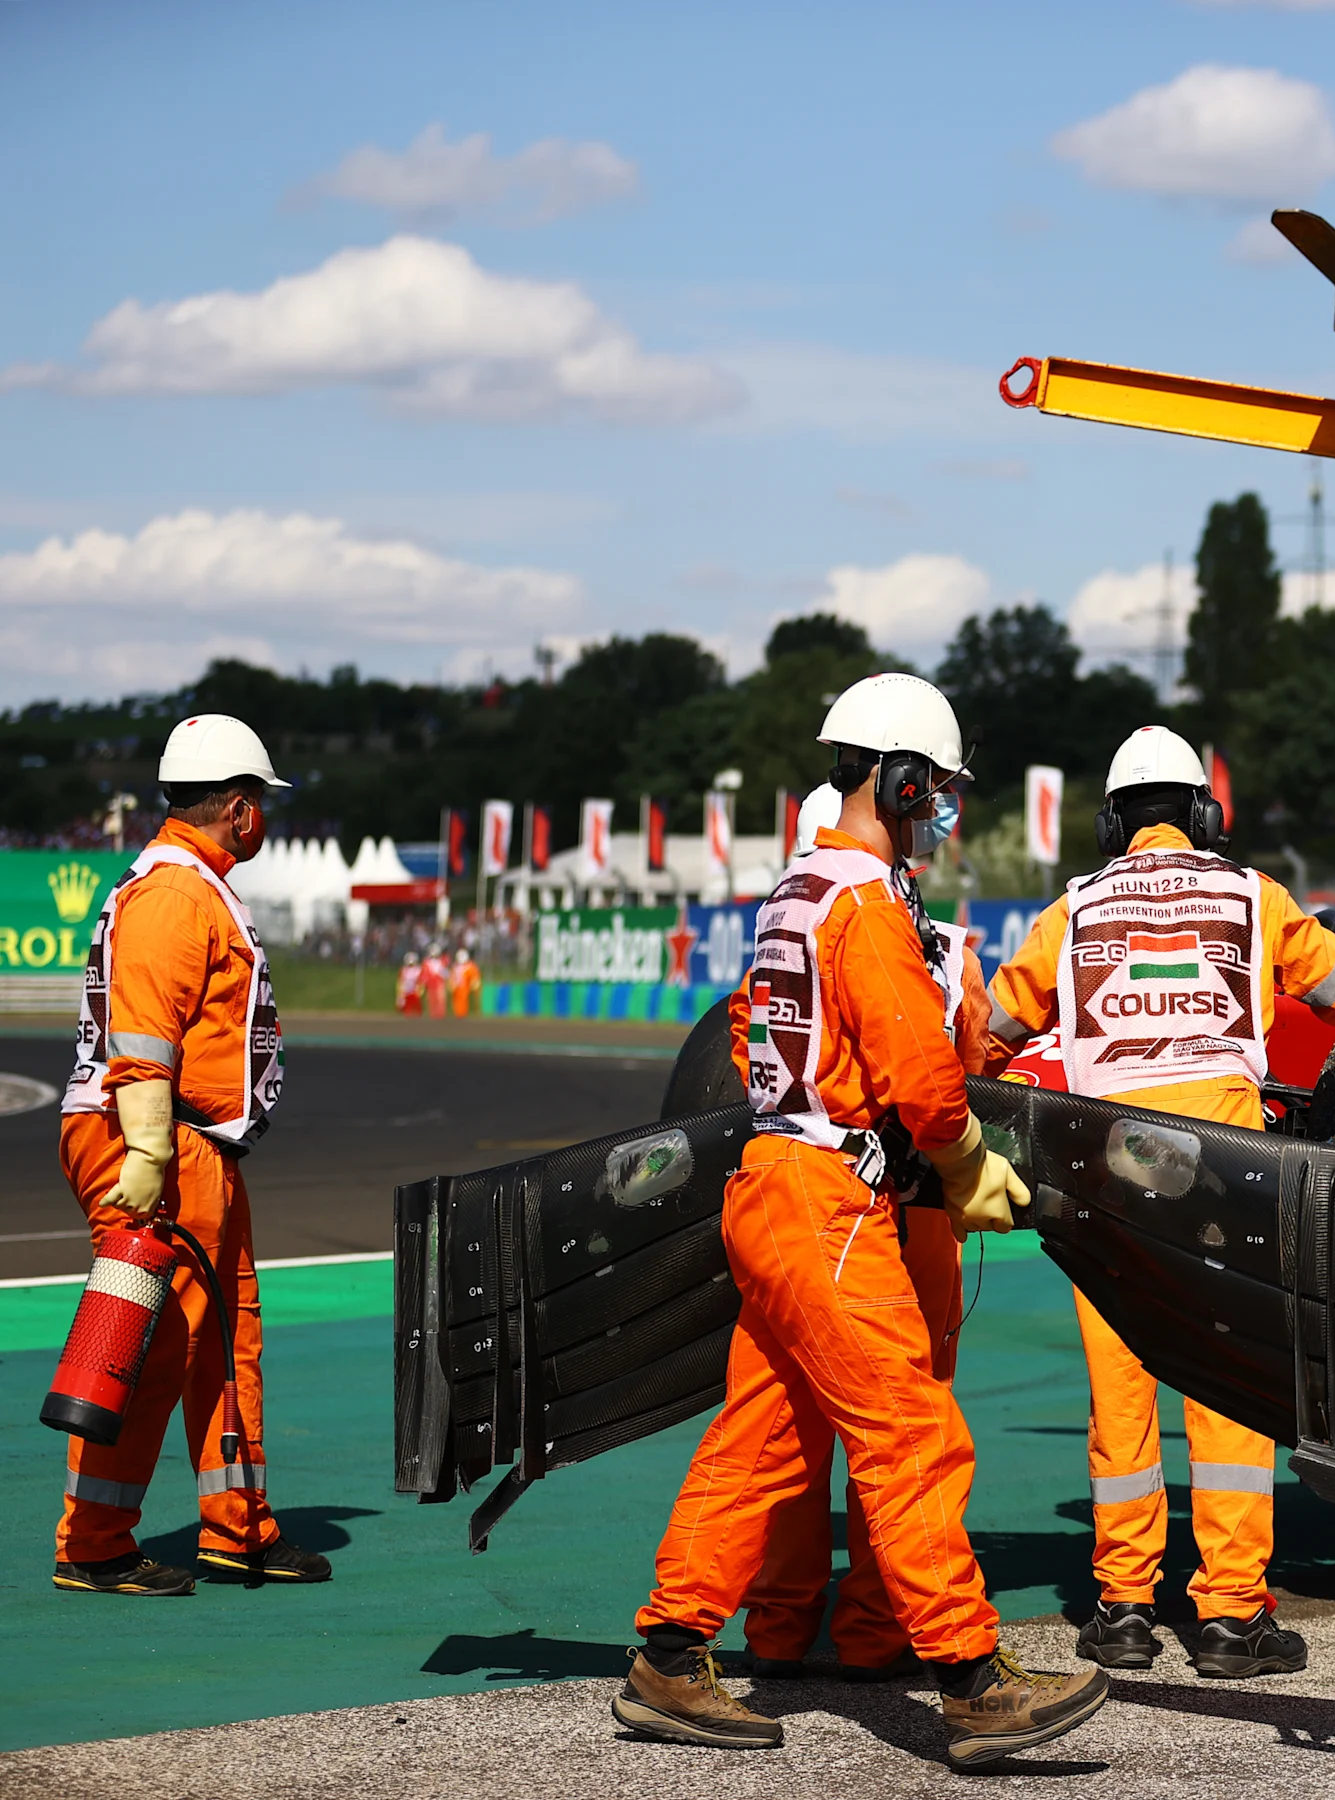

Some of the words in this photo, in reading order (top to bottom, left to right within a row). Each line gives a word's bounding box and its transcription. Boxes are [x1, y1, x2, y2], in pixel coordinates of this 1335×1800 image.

[1100, 906, 1171, 918] INTERVENTION
[1174, 904, 1224, 917] MARSHAL
[0, 927, 92, 967] ROL
[537, 913, 663, 982] Heineken
[1101, 991, 1229, 1020] COURSE
[1245, 1171, 1264, 1181] 05
